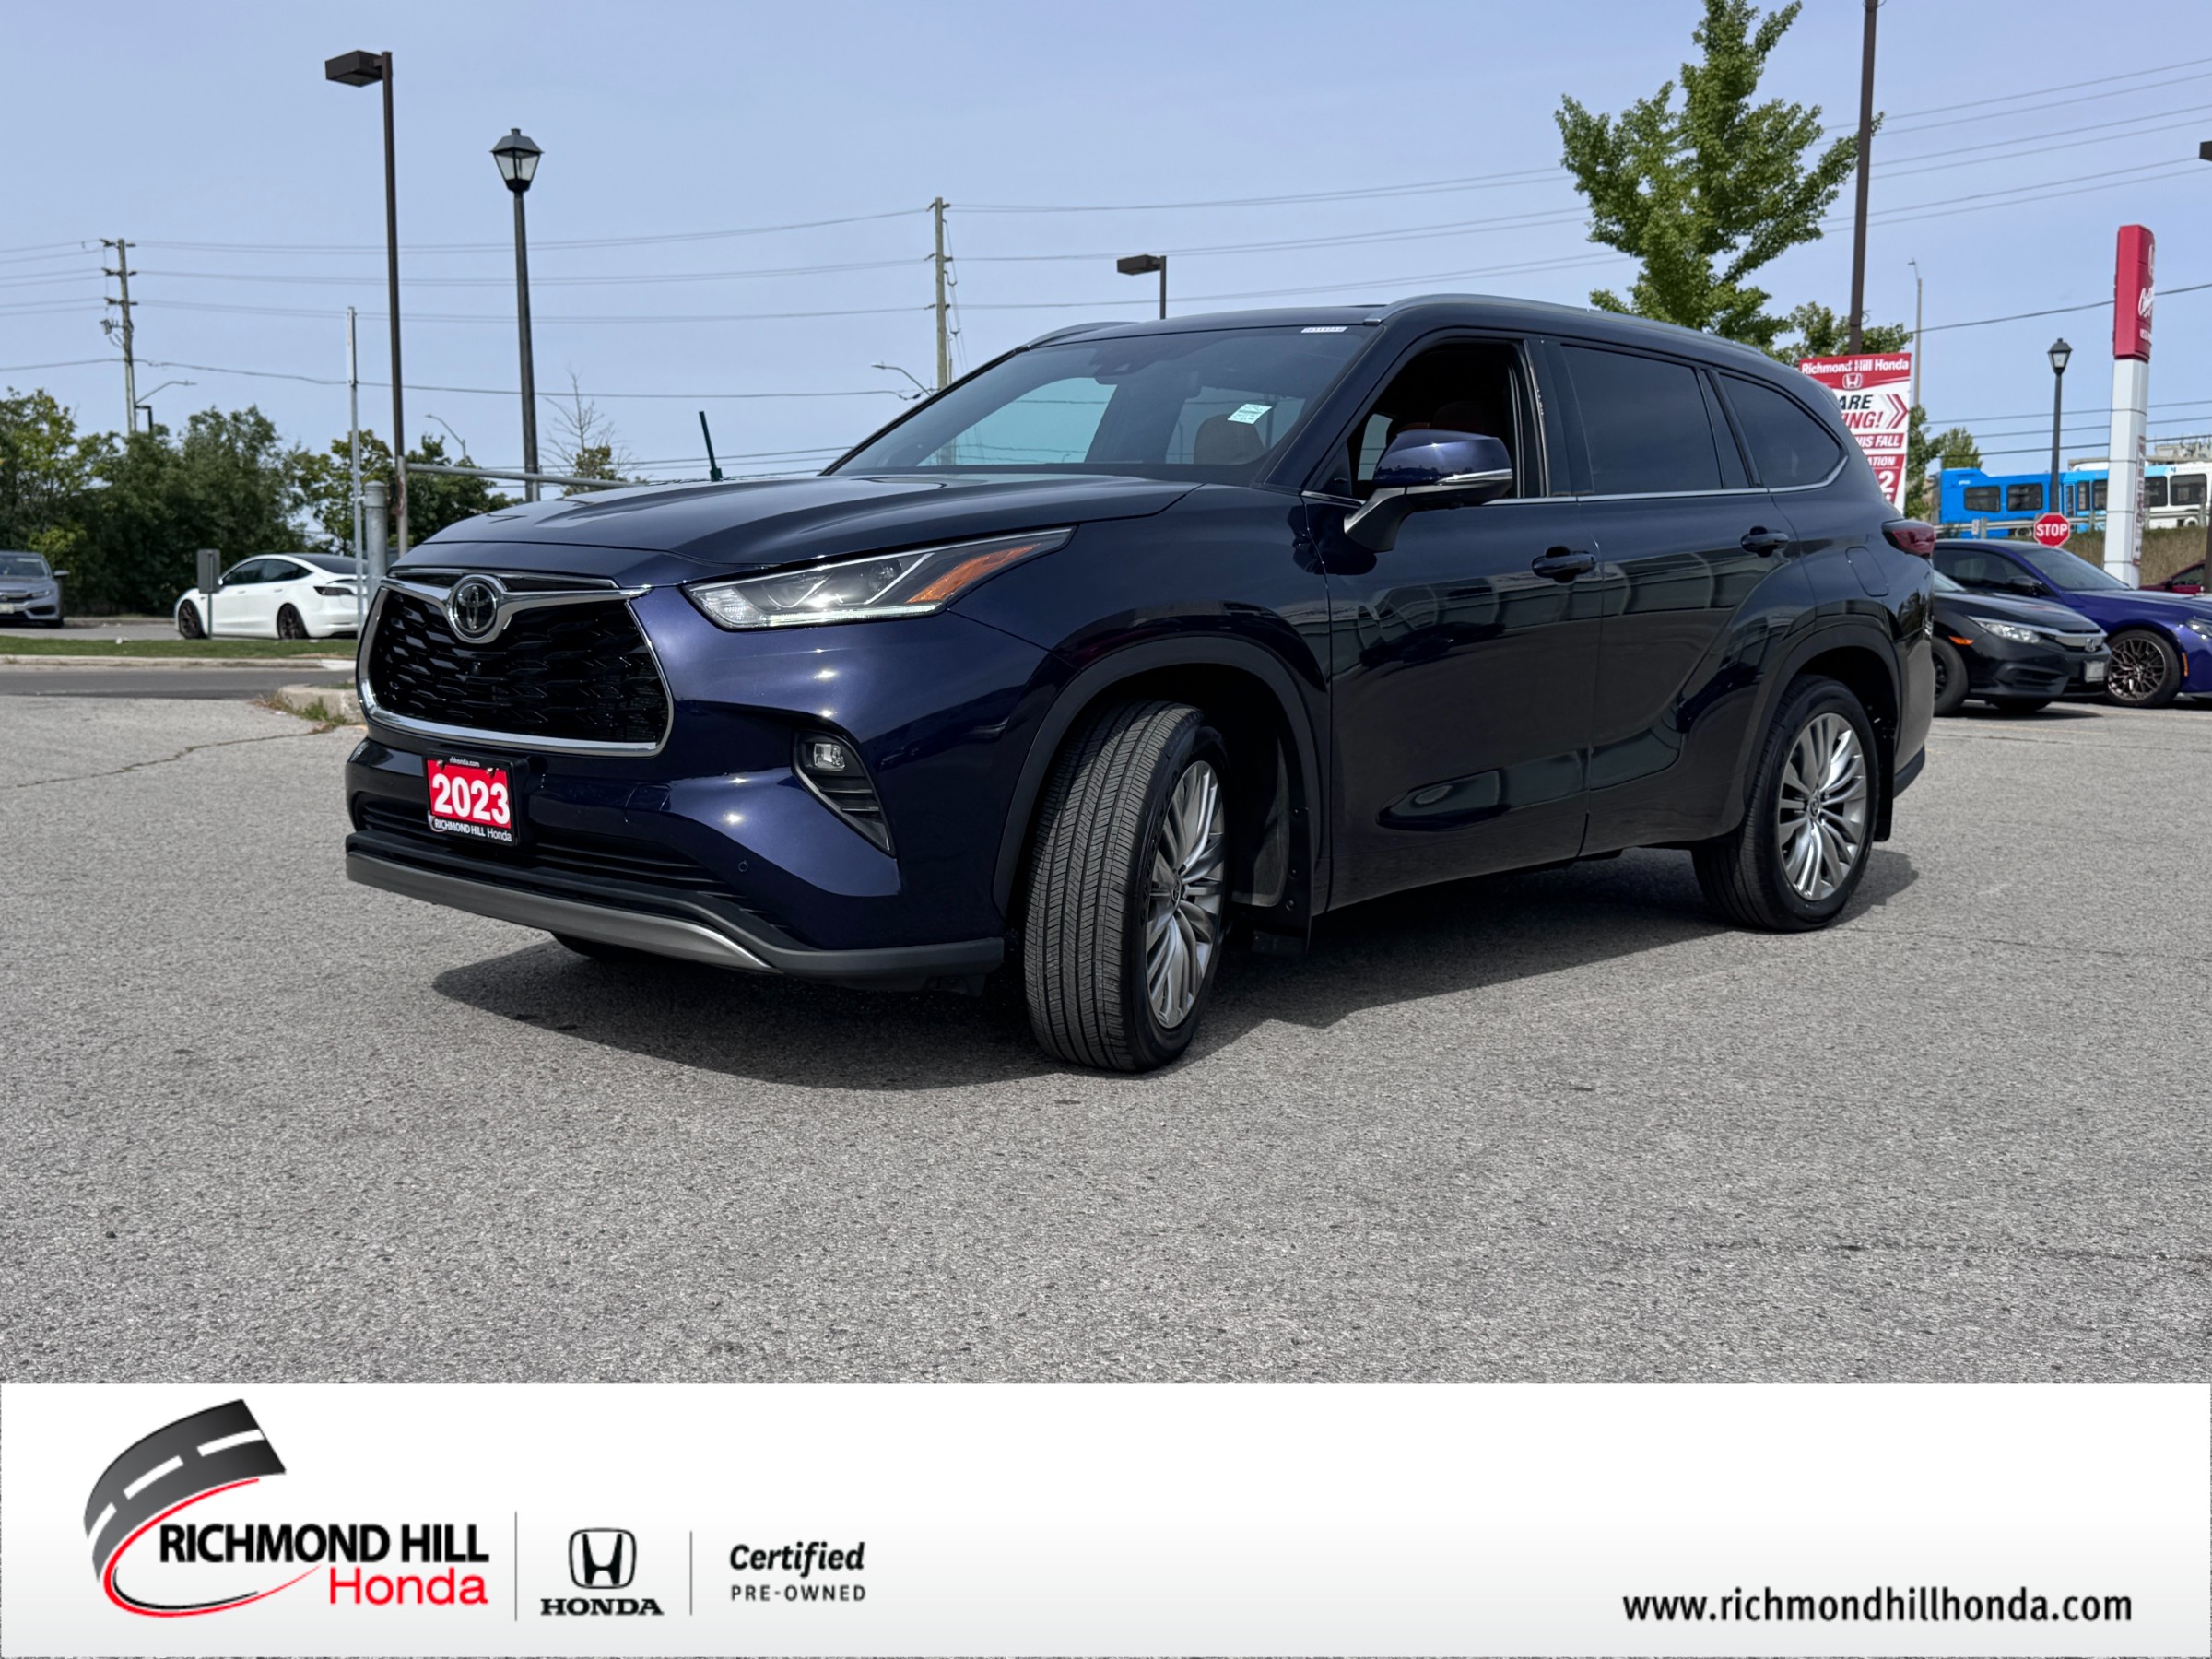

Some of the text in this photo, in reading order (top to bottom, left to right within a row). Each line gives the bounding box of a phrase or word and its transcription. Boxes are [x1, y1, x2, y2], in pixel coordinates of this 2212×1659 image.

[1802, 359, 1909, 374] Richmond Hill Honda
[1840, 394, 1873, 409] ARE
[1842, 411, 1883, 429] ING!
[1855, 435, 1900, 448] HIS FALL
[2036, 523, 2068, 537] STOP
[432, 772, 511, 826] 2023
[434, 818, 512, 841] RICHMOND HILL Honda
